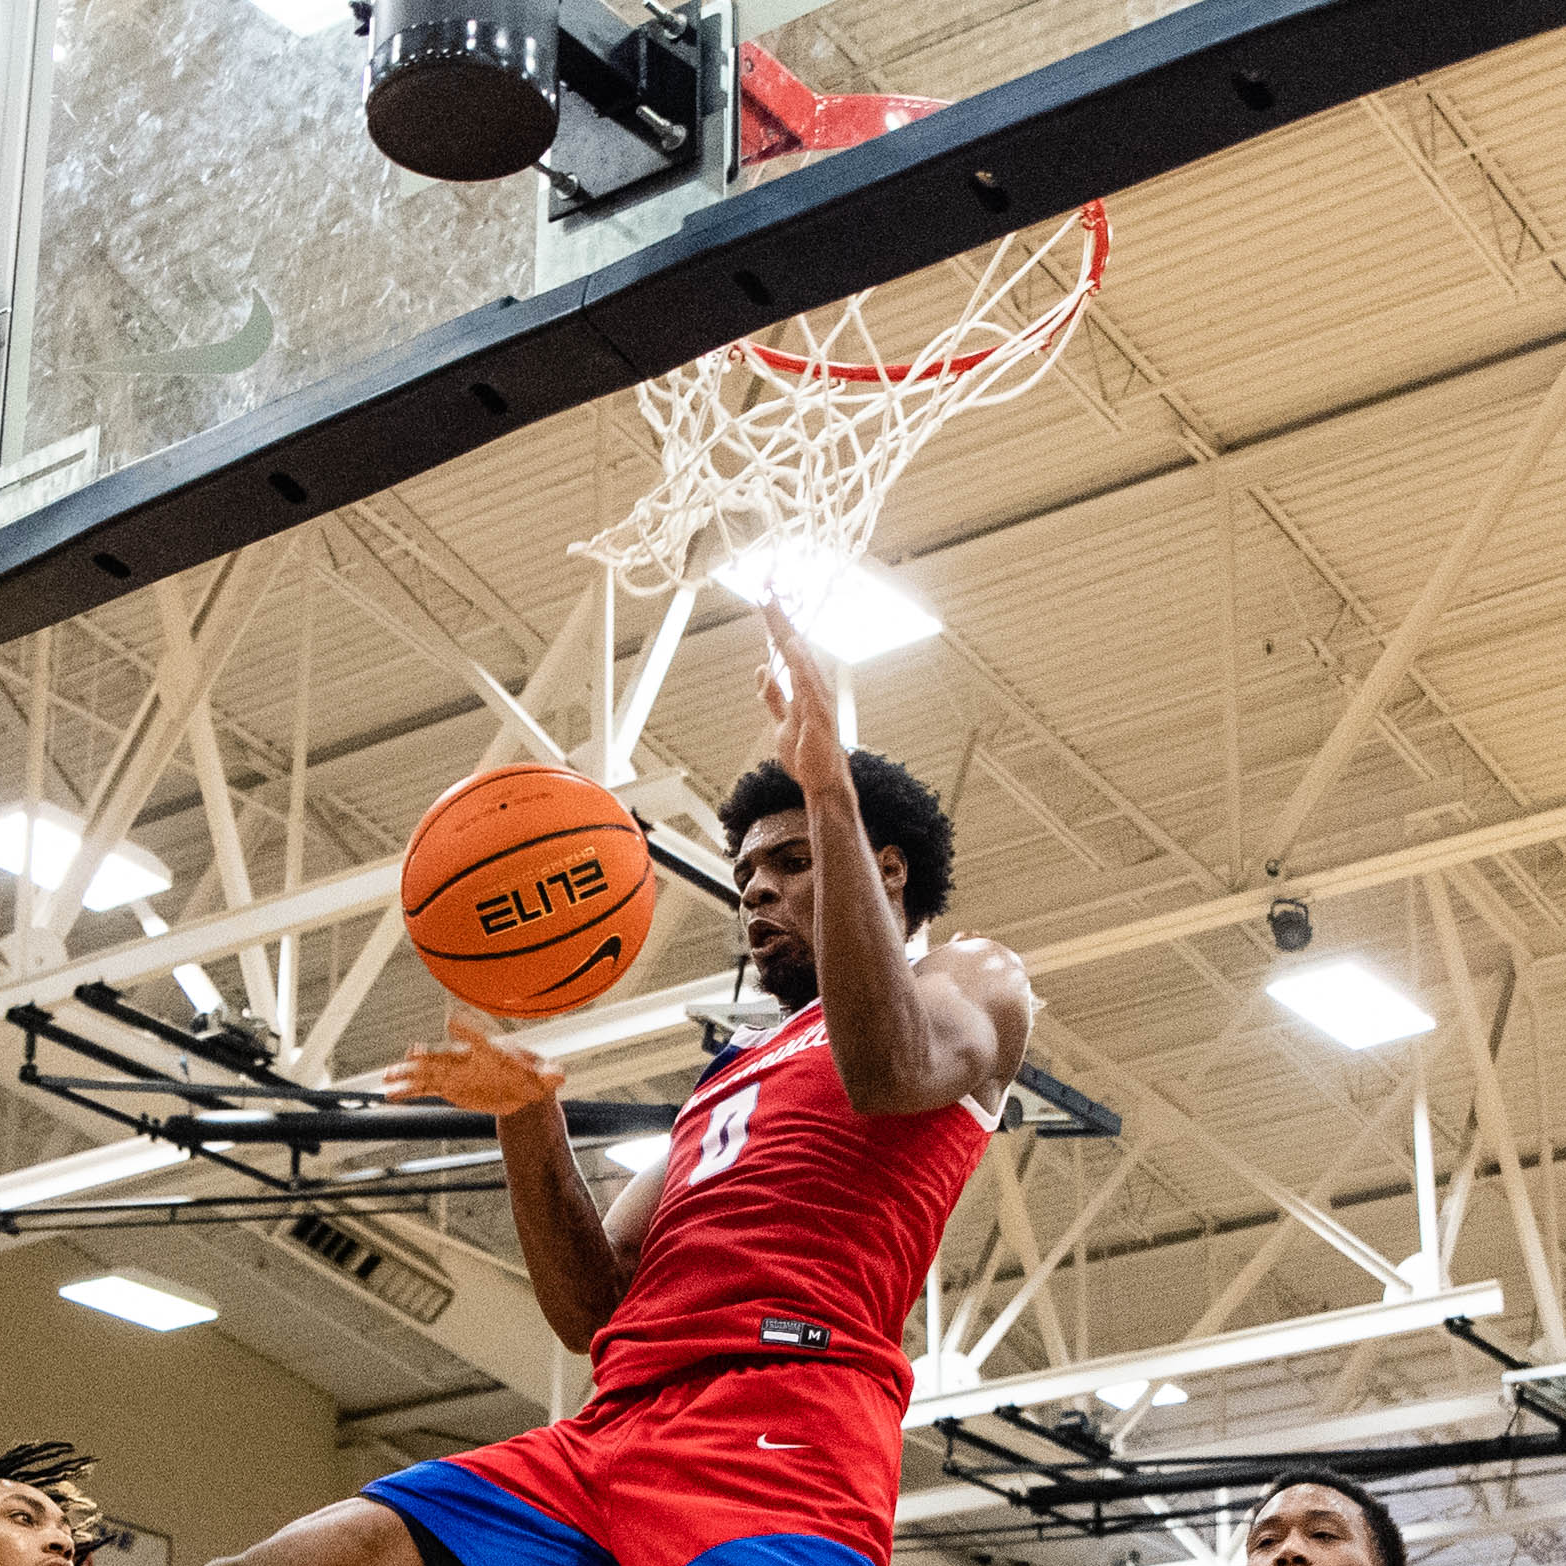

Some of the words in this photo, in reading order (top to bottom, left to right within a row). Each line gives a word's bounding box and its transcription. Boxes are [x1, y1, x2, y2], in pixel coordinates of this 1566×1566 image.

[475, 857, 609, 936] ELITE
[688, 1080, 761, 1187] 0
[807, 1329, 821, 1341] M
